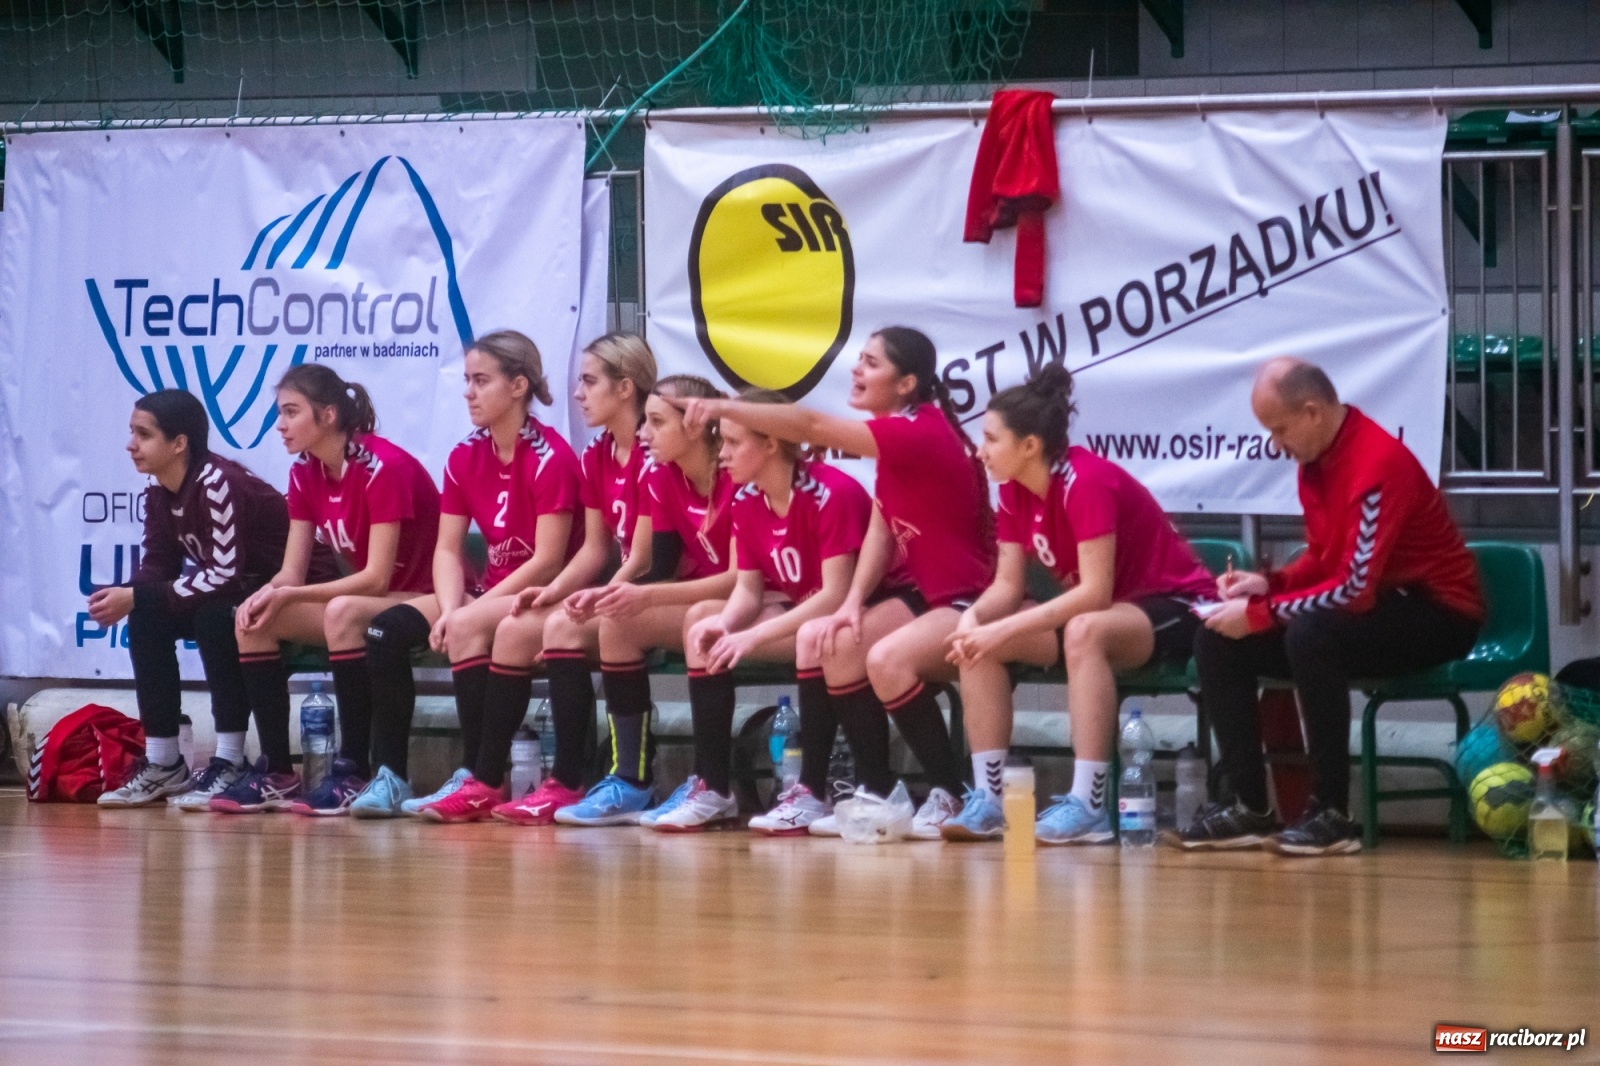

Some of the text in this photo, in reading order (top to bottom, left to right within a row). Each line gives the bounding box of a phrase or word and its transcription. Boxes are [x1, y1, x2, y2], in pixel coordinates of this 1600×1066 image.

[114, 276, 438, 337] TechControl
[942, 171, 1396, 414] ST W PORZĄDKU!
[315, 342, 439, 361] partner w badaniach
[1087, 426, 1293, 461] www.osir-rac
[493, 491, 509, 528] 2
[611, 499, 627, 538] 2
[323, 518, 357, 553] 14
[1032, 532, 1056, 567] 8
[770, 546, 801, 583] 10
